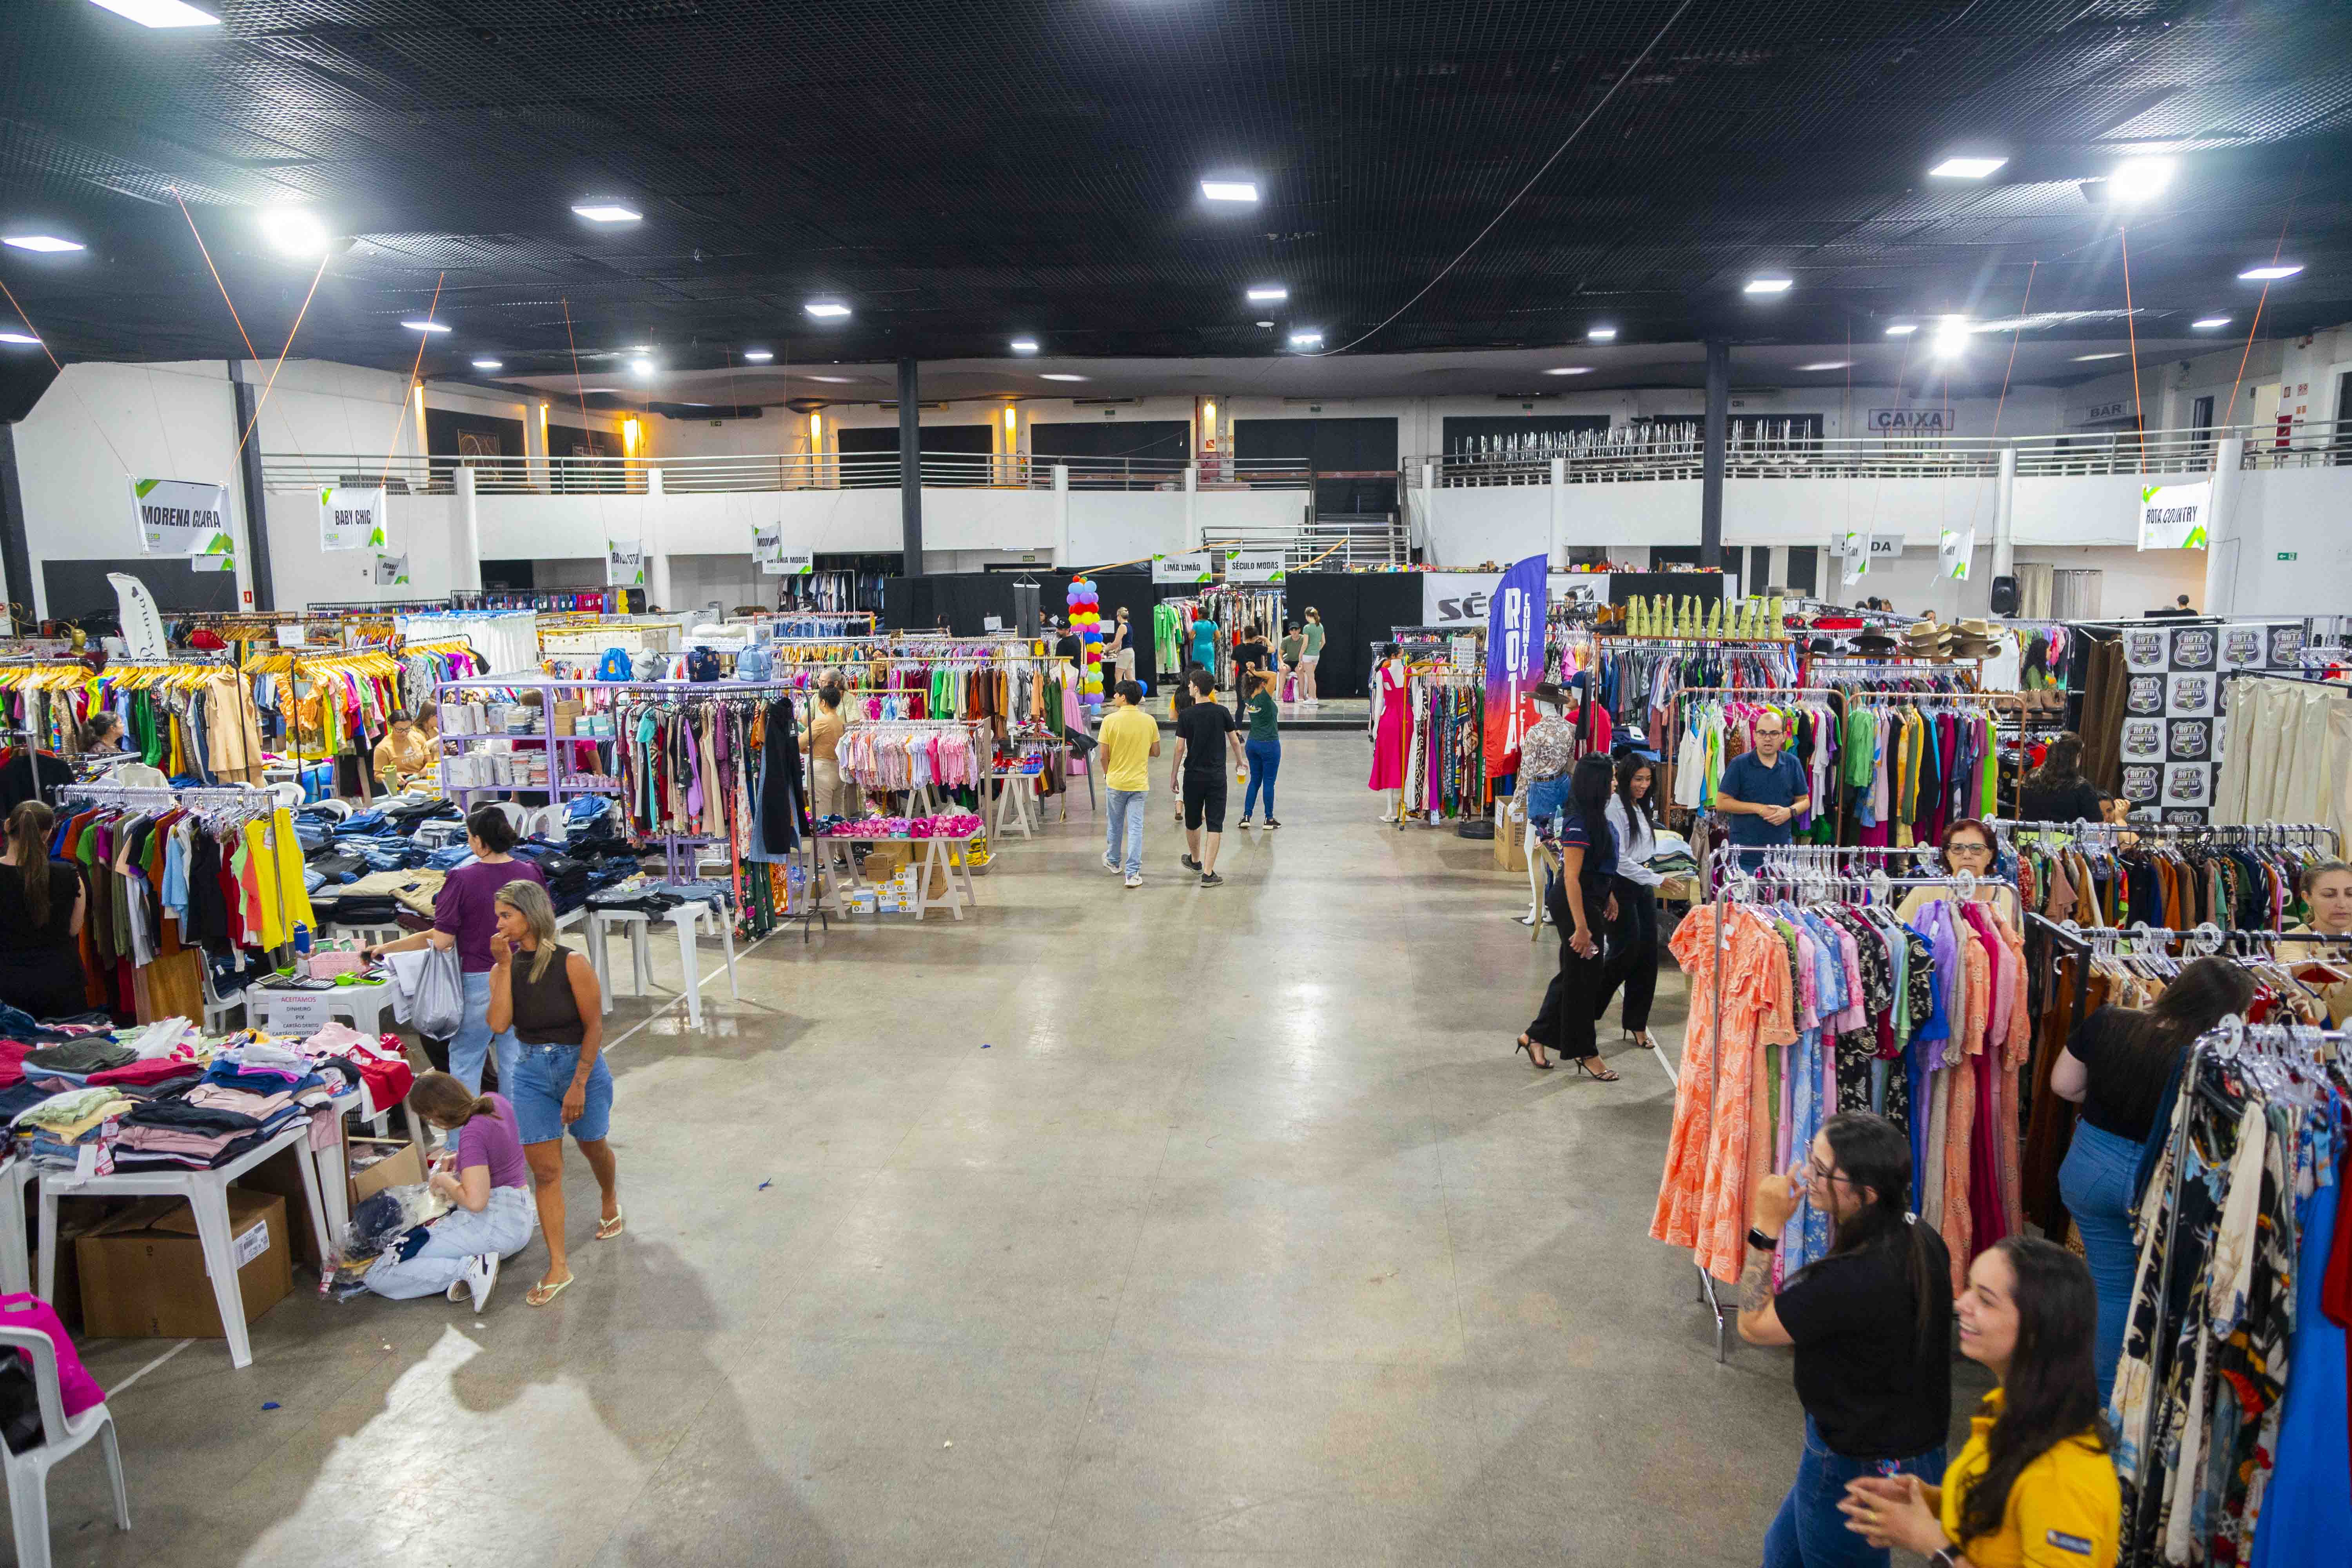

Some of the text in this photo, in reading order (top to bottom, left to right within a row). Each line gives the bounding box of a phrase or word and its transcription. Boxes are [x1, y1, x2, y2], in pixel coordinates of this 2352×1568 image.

[2091, 405, 2121, 417] BAR
[1878, 412, 1942, 427] CAIXA
[142, 505, 221, 528] MORENA CLARA
[335, 510, 371, 525] BABY CHIC
[2147, 505, 2198, 524] ROTA COUNTRY
[1181, 562, 1201, 572] LIMÃO
[1232, 561, 1279, 570] SÉCULO MODAS
[1521, 593, 1530, 680] COUNTRY
